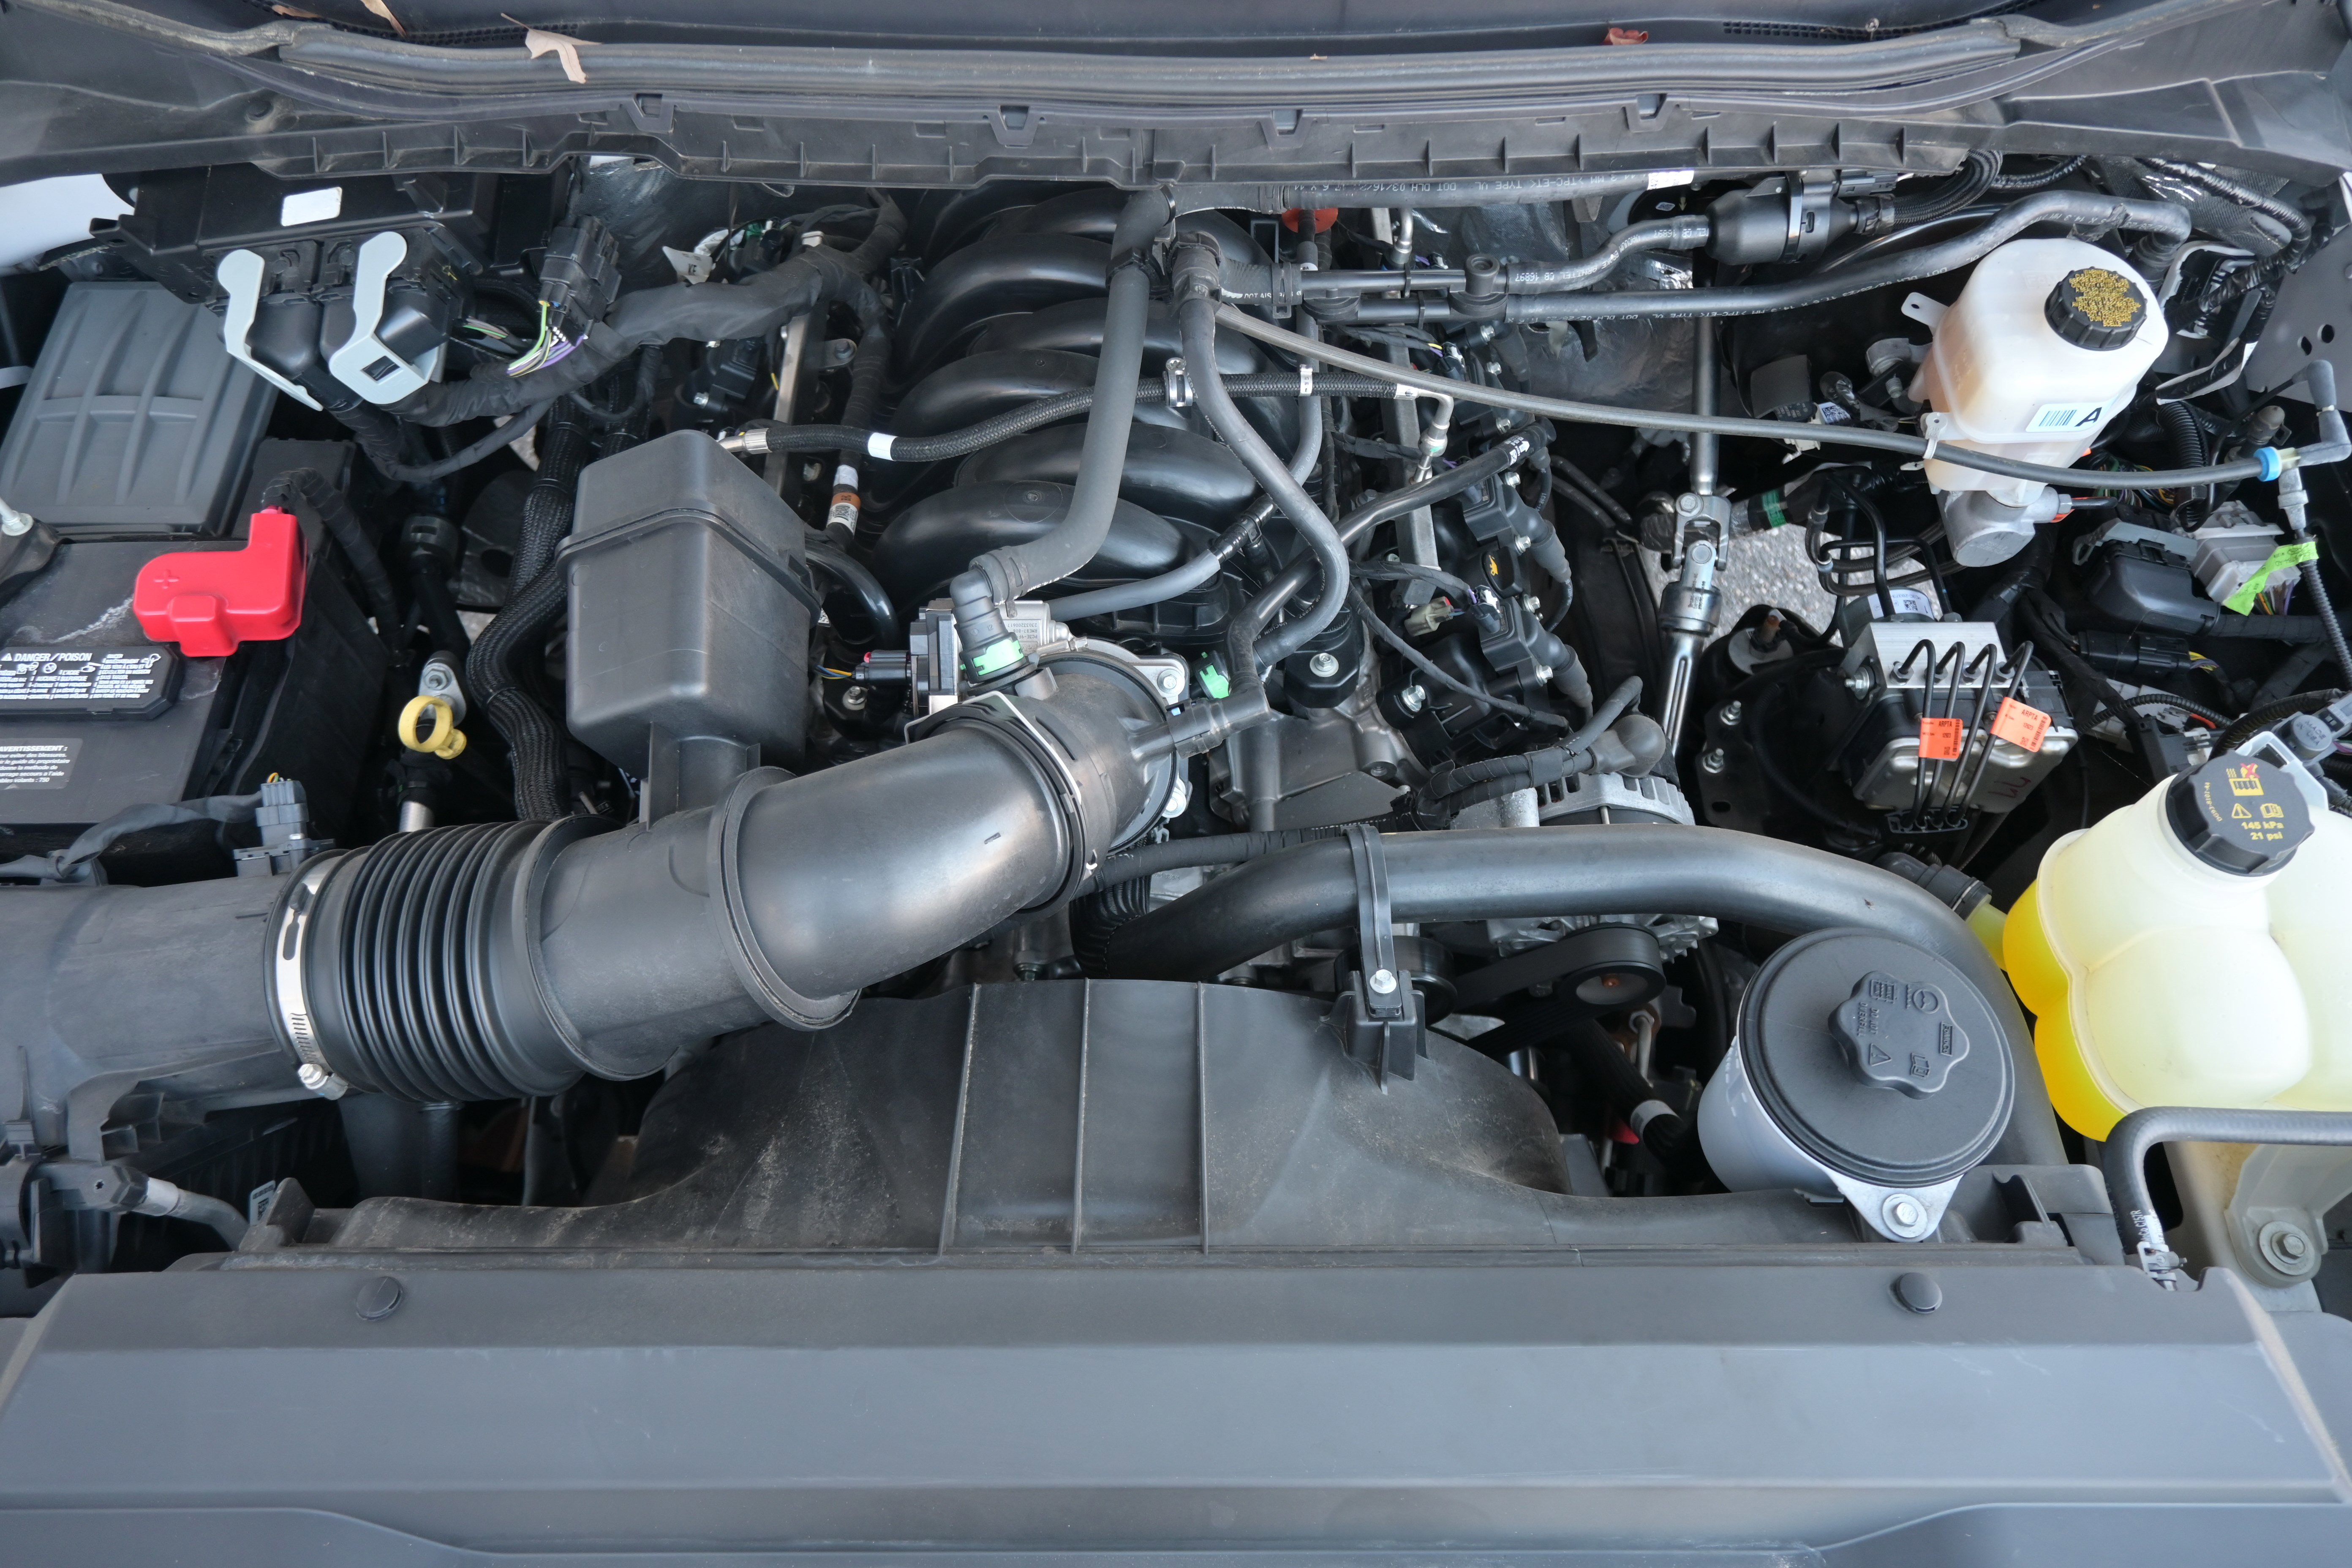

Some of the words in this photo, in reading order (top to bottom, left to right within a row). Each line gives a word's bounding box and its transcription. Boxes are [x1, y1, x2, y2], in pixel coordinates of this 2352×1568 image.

[1411, 183, 1430, 192] DLH
[1436, 183, 1456, 191] DOT
[1495, 180, 1522, 190] TYPE
[1654, 229, 1677, 238] 16897
[1515, 272, 1540, 282] 16897
[1544, 272, 1554, 281] CB
[2075, 407, 2102, 427] A
[1264, 621, 1288, 635] VACUUM
[14, 653, 93, 662] DANGER/POISON
[2021, 708, 2039, 721] ARPTA
[2241, 822, 2262, 830] 145
[2262, 821, 2284, 829] kPa
[2250, 832, 2264, 840] 21
[2266, 831, 2284, 841] psi
[1870, 1007, 1879, 1018] DO
[1857, 1002, 1868, 1037] OVERFILL
[1942, 1024, 1950, 1055] FoMoCo
[2129, 1209, 2147, 1228] C757R
[2137, 1228, 2151, 1243] MoCo
